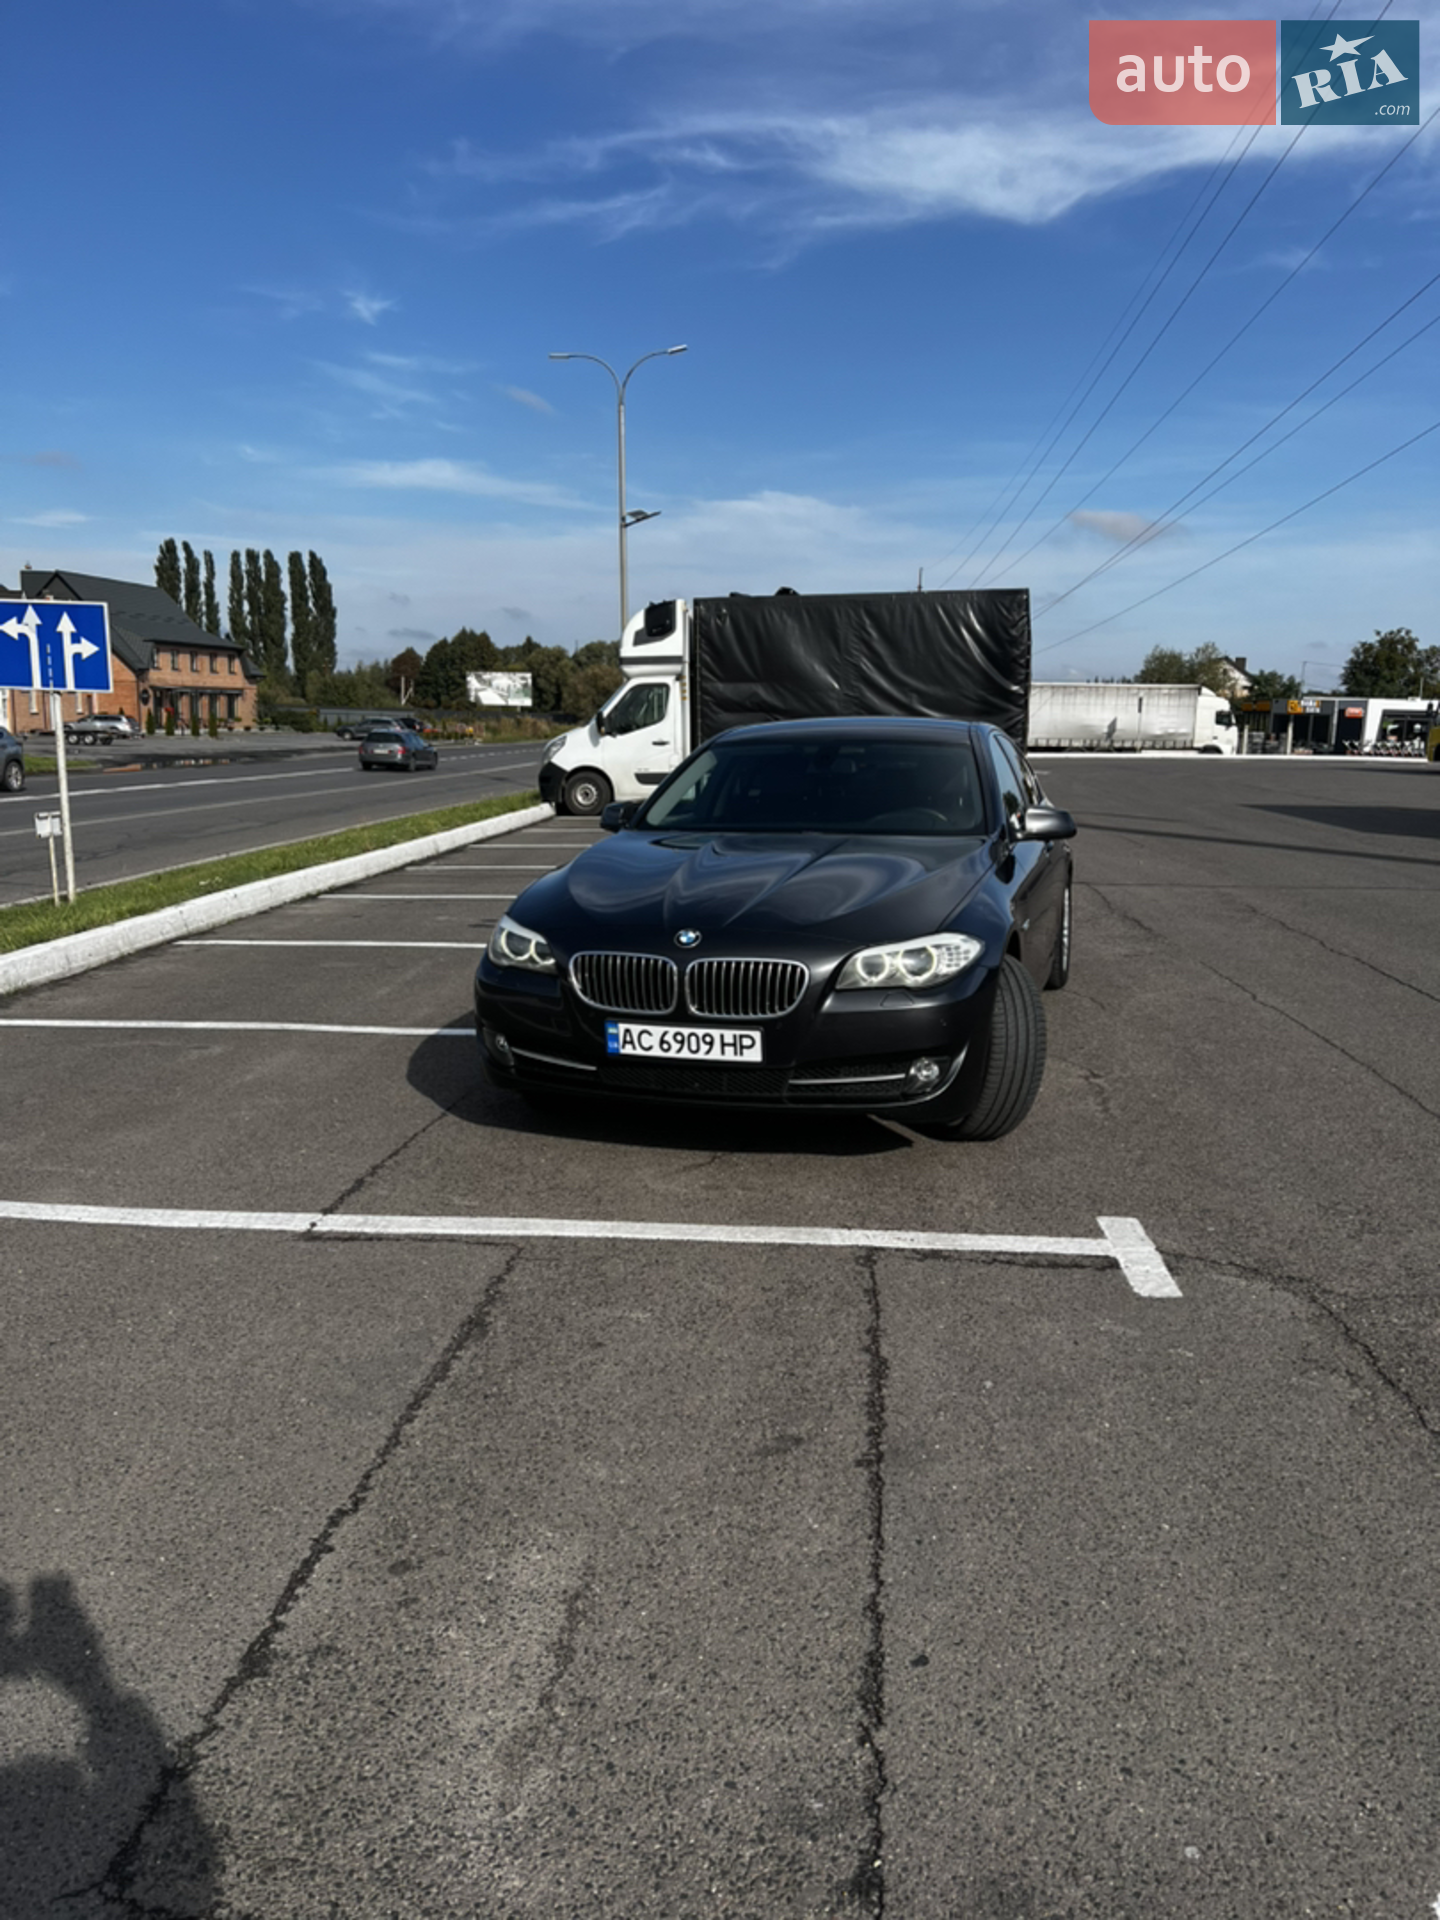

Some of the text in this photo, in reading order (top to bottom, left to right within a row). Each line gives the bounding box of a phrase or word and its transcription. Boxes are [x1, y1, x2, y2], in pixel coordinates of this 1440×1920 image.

[621, 1027, 756, 1057] AC 6909 HP
